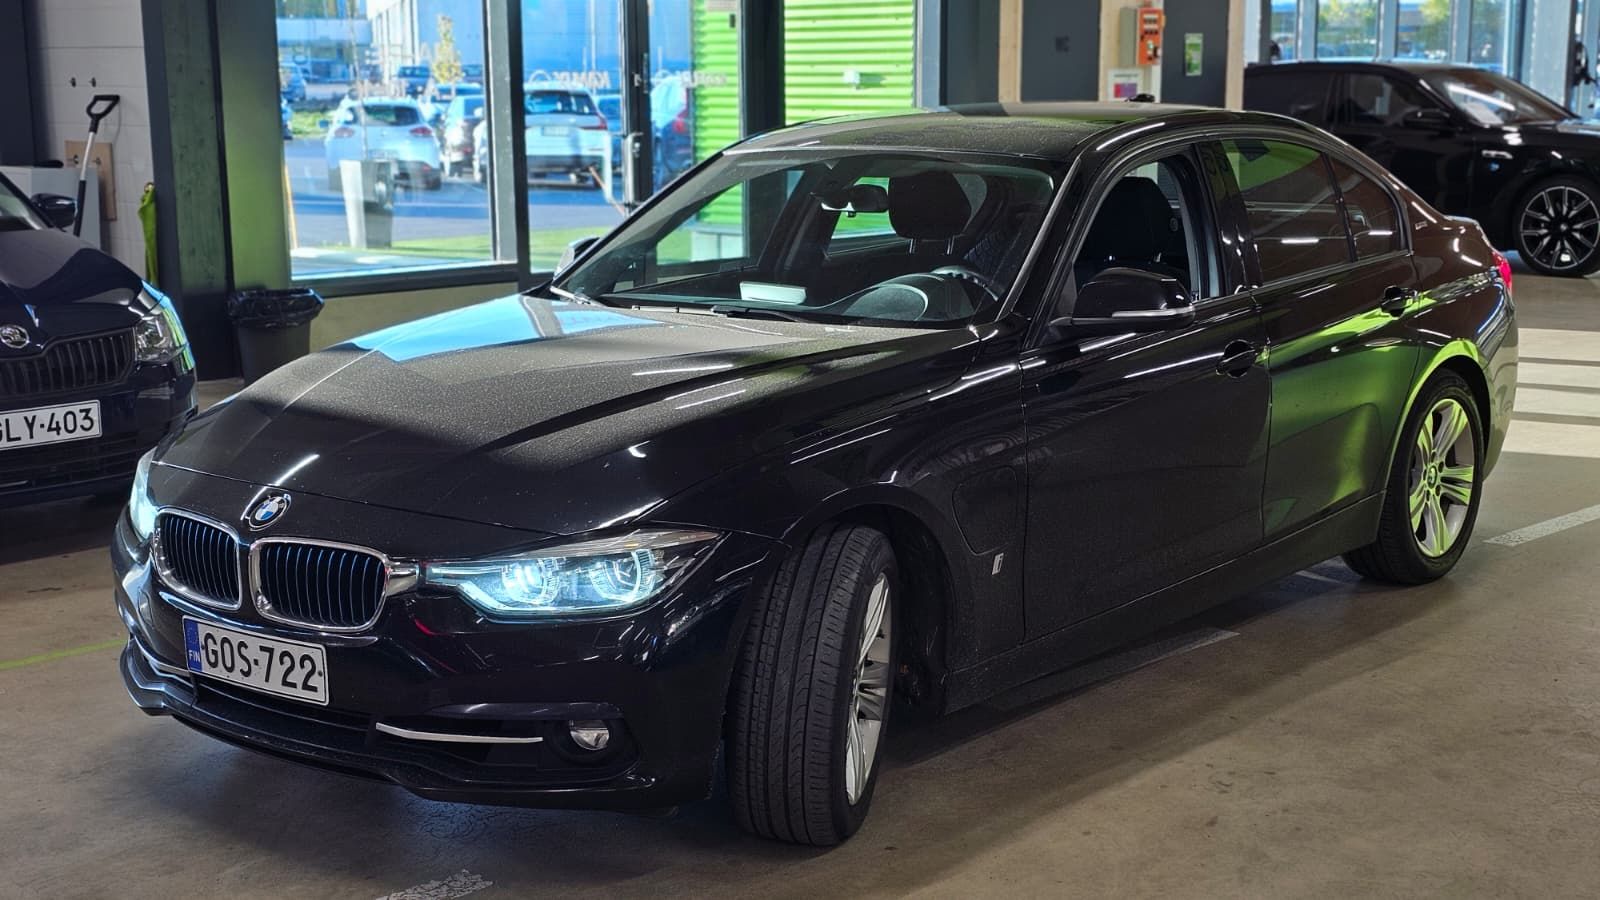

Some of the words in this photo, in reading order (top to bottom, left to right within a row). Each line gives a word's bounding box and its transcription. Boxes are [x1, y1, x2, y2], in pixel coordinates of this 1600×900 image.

[0, 407, 94, 442] LY-403
[188, 649, 201, 662] FIN
[204, 632, 319, 693] GOS-722
